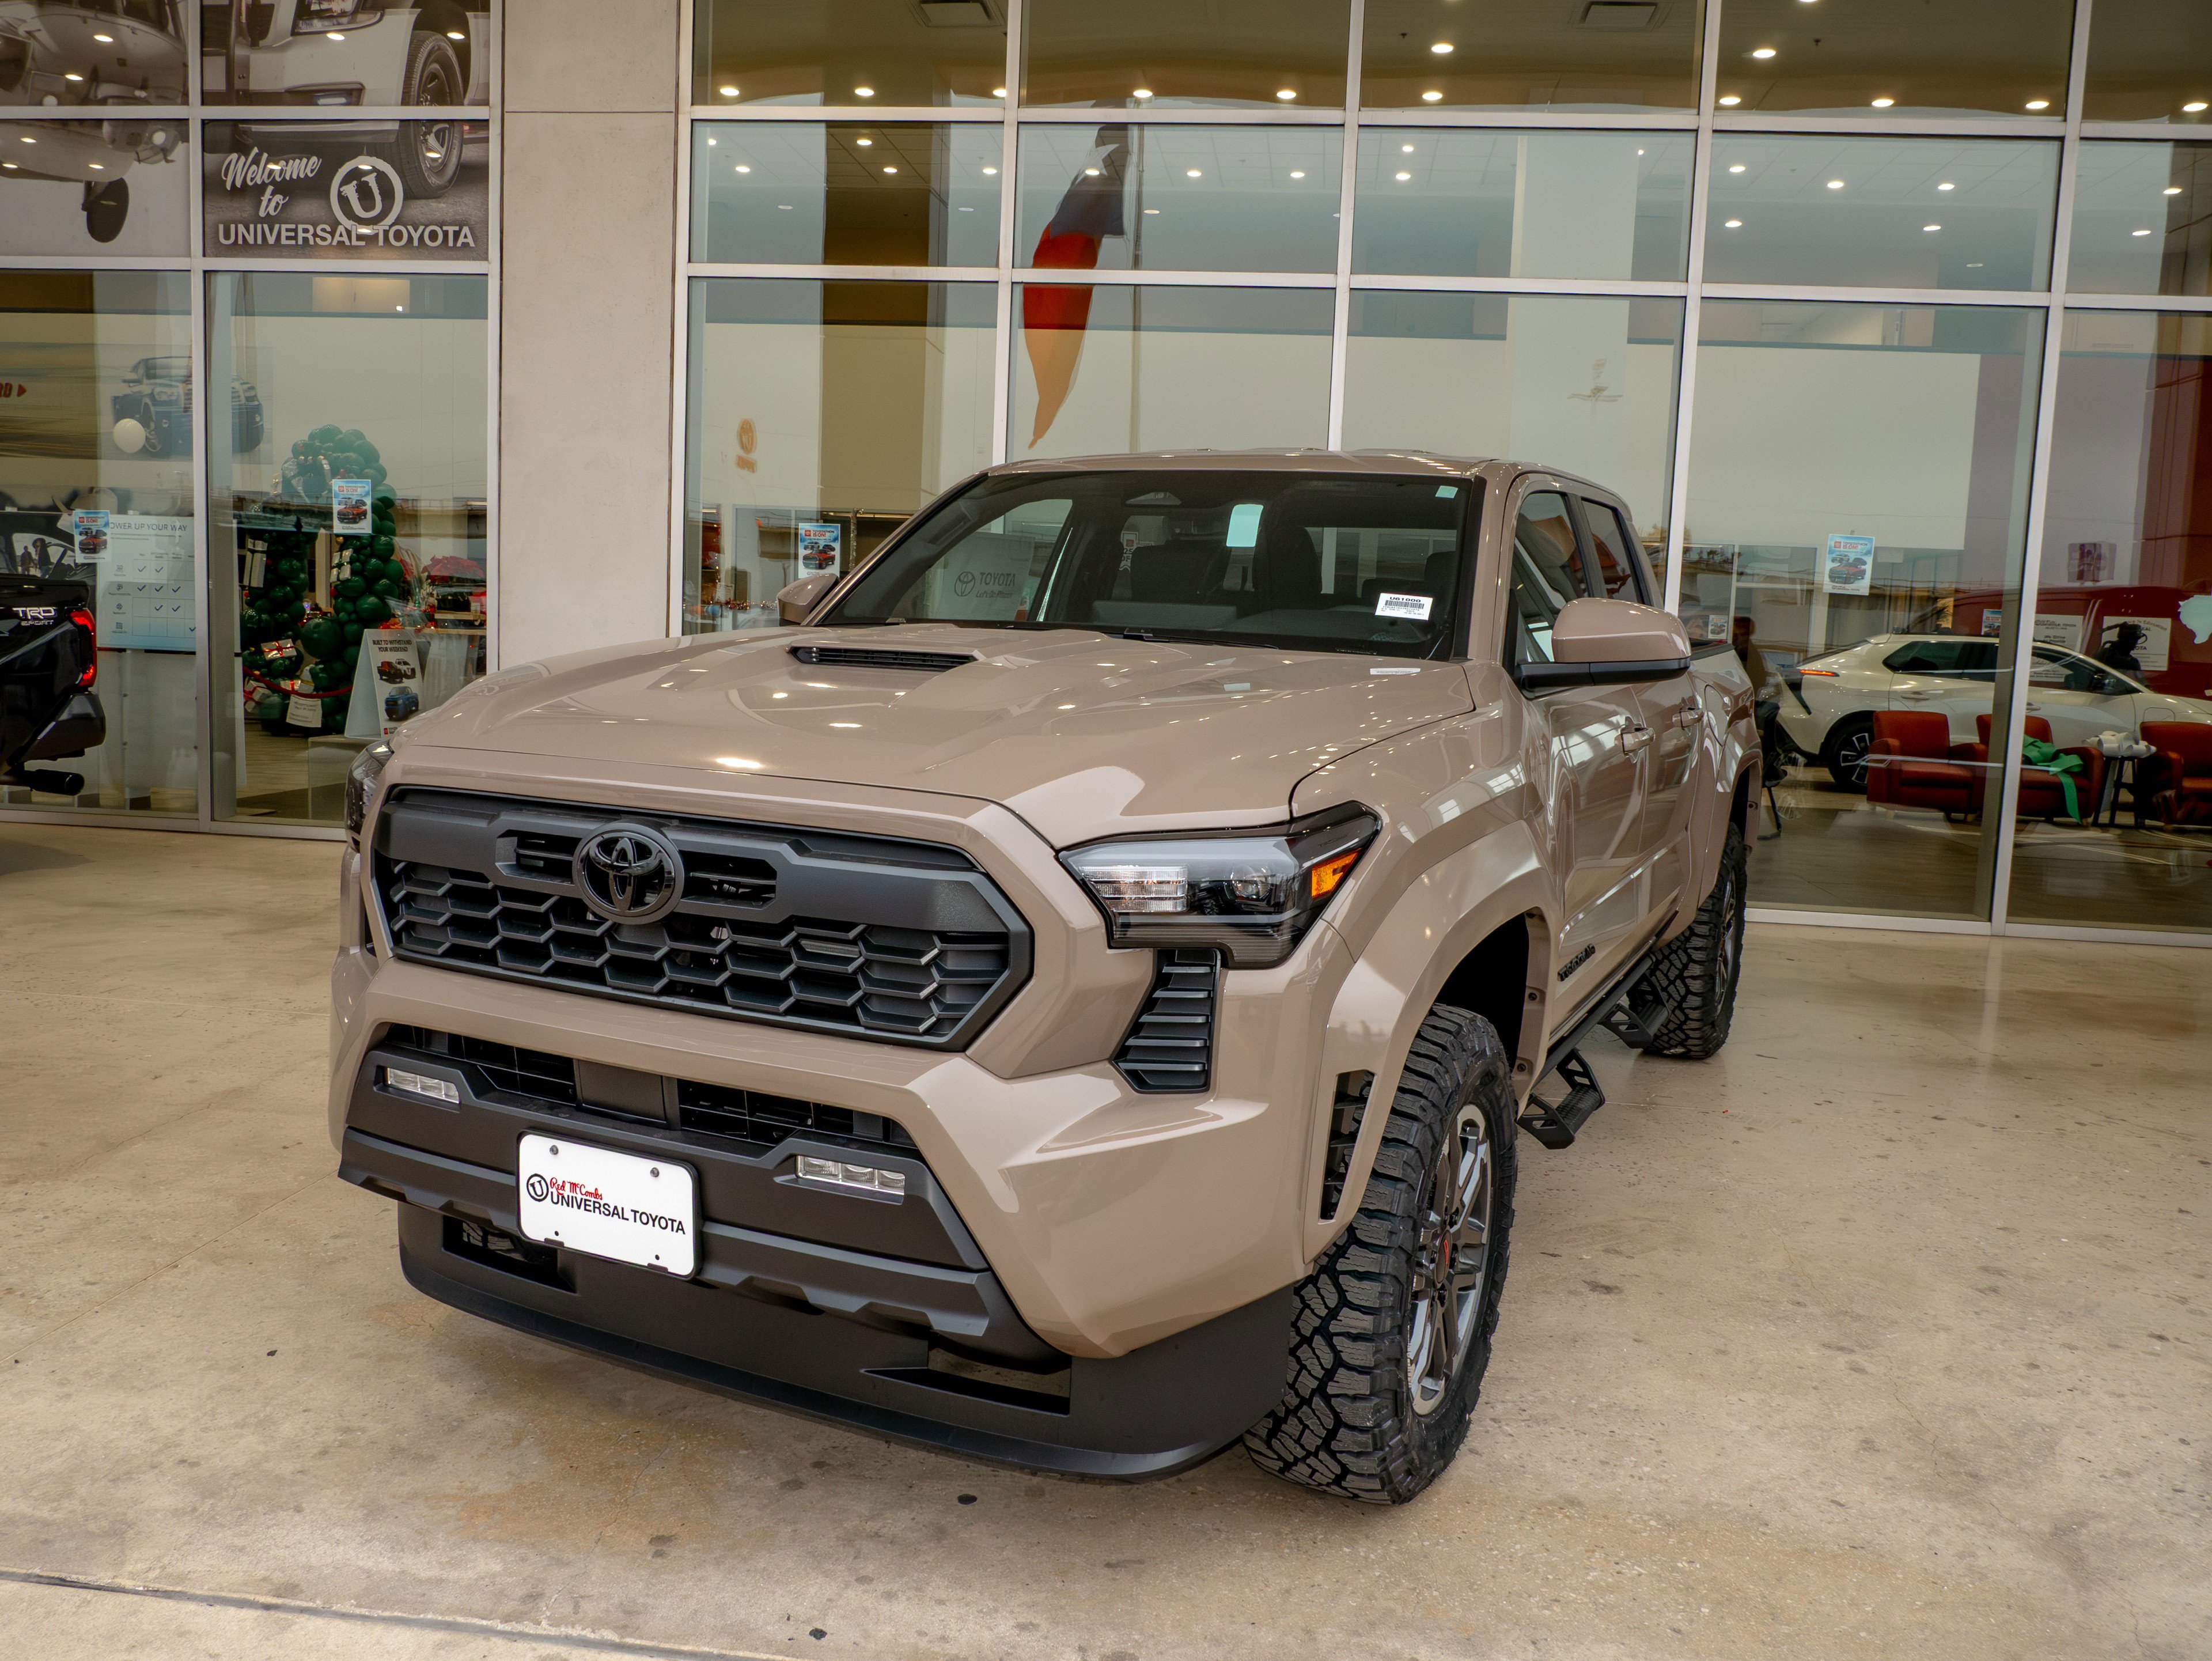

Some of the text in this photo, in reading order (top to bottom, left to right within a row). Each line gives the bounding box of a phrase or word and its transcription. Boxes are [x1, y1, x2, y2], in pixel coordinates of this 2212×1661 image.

[221, 146, 322, 191] Welcome
[259, 185, 289, 217] to
[218, 223, 475, 248] UNIVERSAL TOYOTA
[980, 572, 1016, 586] TOYOTA
[12, 607, 55, 619] TRD
[550, 1176, 566, 1196] Red
[550, 1190, 685, 1235] UNIVERSAL TOYOTA
